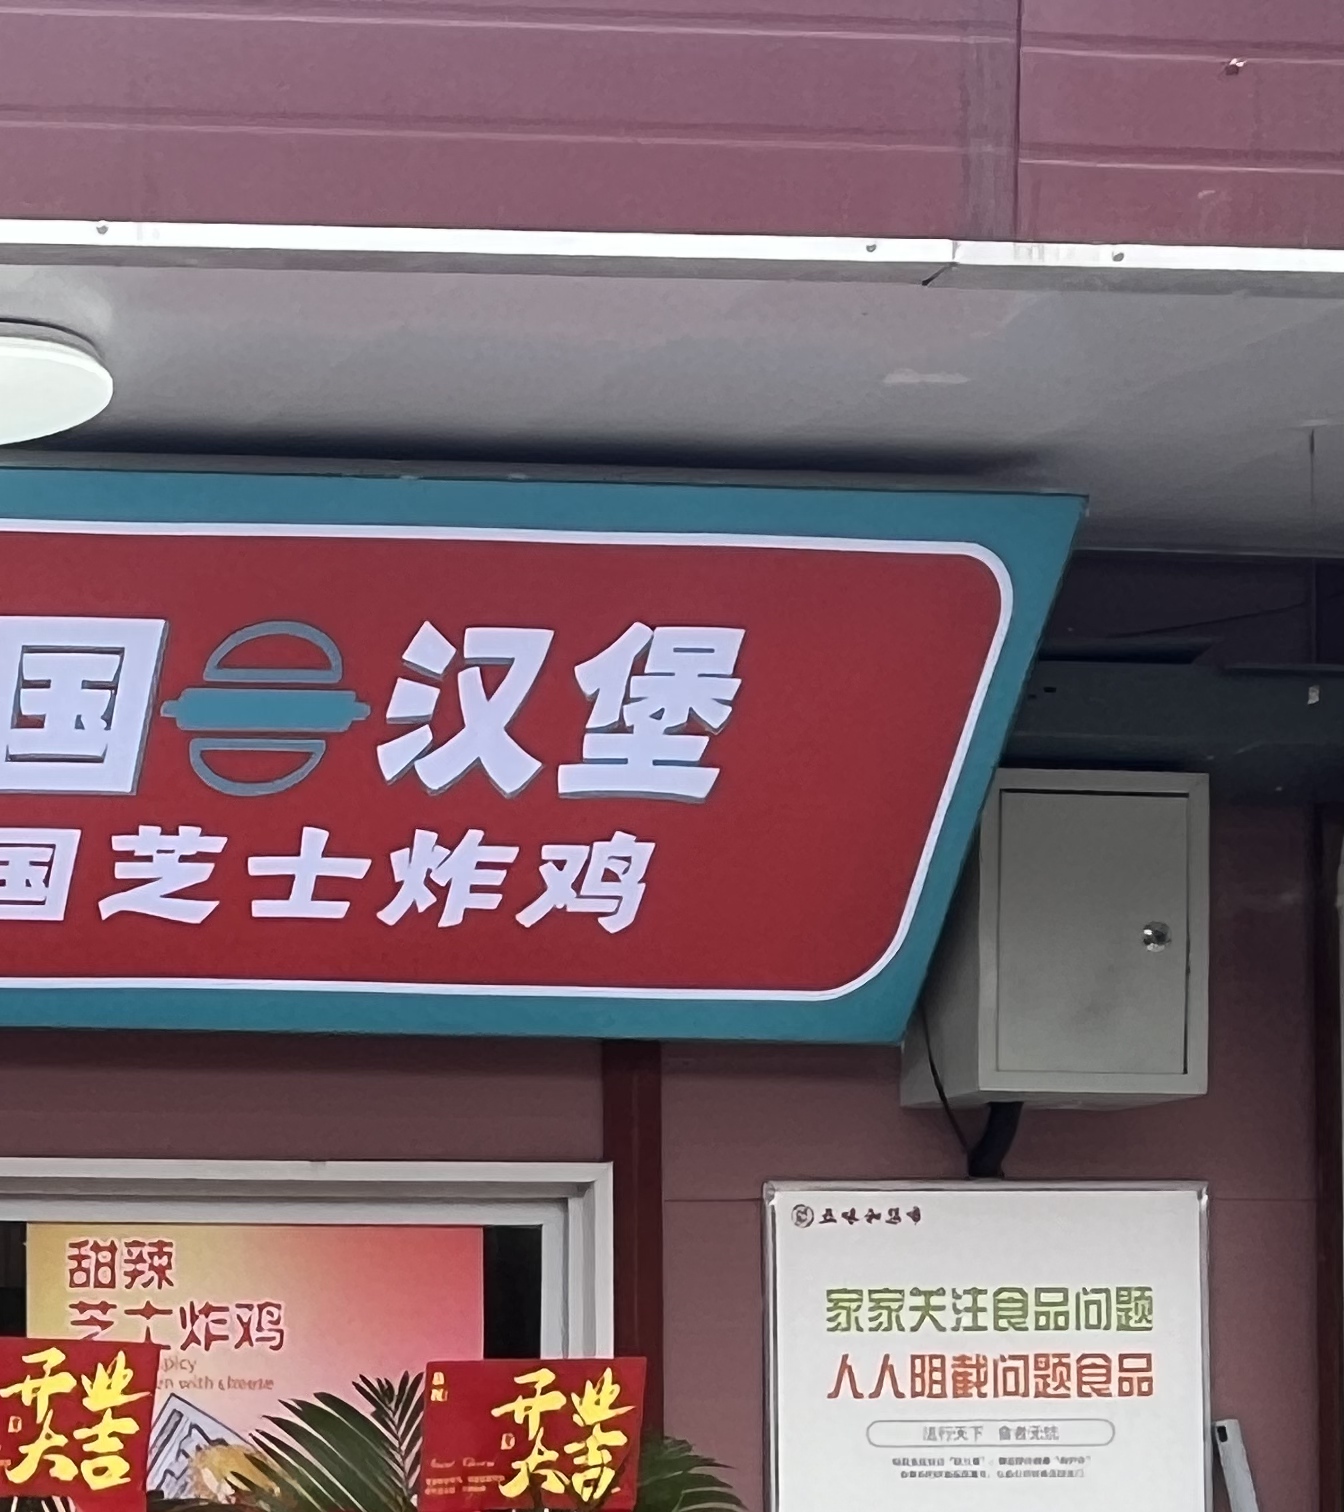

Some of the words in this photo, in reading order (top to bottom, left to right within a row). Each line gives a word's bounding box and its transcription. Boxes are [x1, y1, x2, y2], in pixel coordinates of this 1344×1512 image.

[376, 620, 745, 804] 汉堡
[68, 1240, 174, 1289] 甜辣
[825, 1286, 1154, 1333] 家家关注食品问题
[826, 1353, 1155, 1400] 人人阻截问题食品
